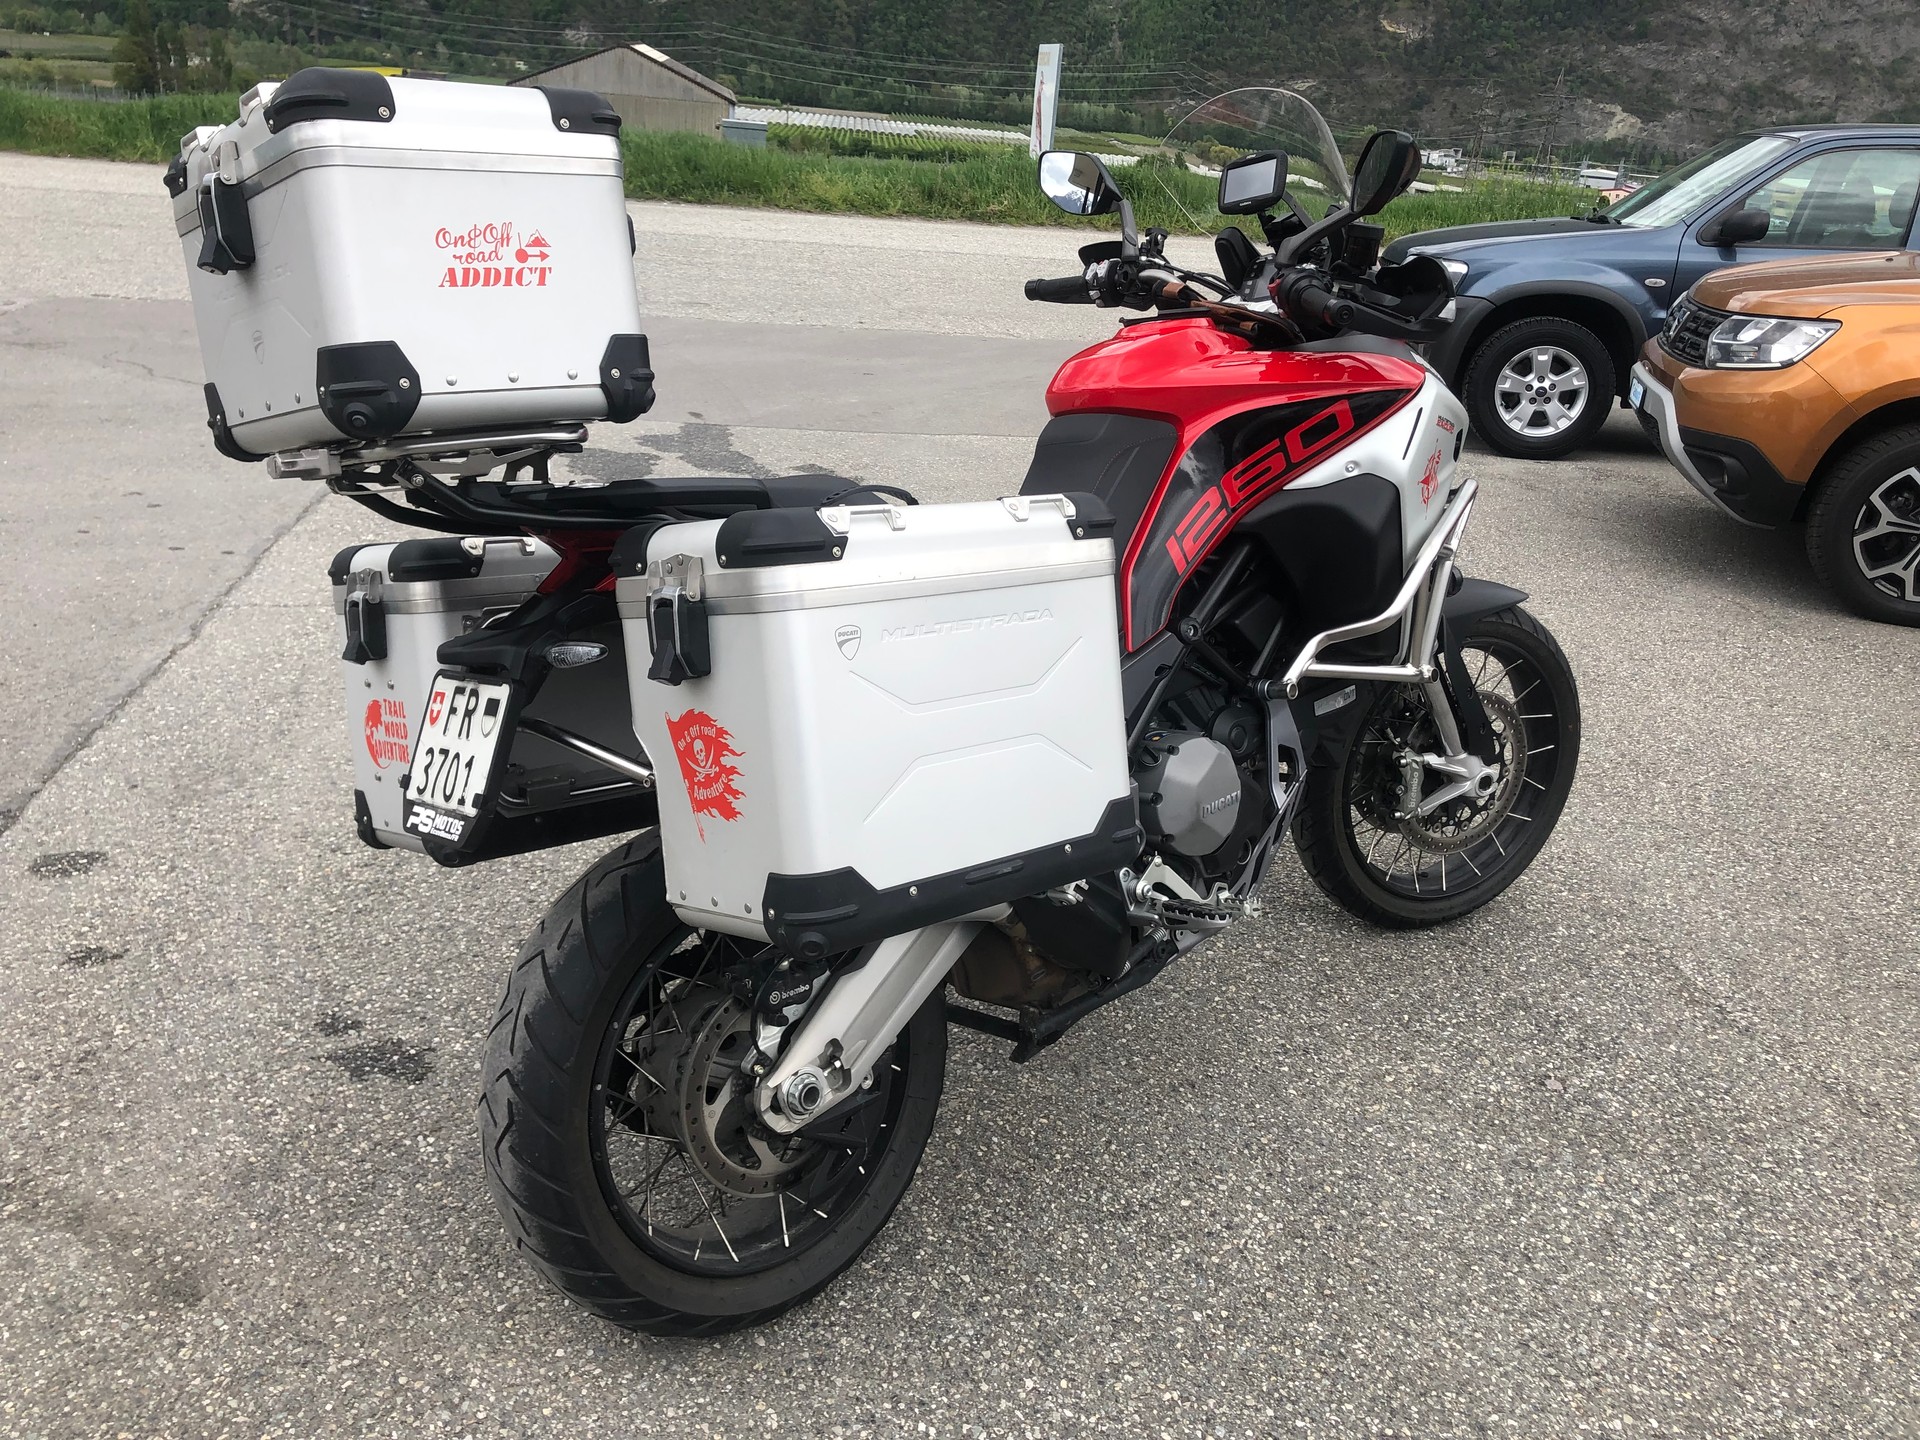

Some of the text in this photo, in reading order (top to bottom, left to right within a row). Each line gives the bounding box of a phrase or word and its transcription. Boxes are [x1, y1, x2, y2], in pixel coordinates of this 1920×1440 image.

[452, 240, 503, 265] road
[438, 267, 552, 287] ADDICT
[1165, 399, 1355, 576] 1260
[837, 629, 859, 638] DUCATI
[881, 608, 1054, 643] MULTISTRADA
[383, 698, 406, 719] TRAIL
[442, 685, 480, 741] FR
[384, 720, 408, 740] WORLD
[677, 738, 687, 751] On
[690, 724, 700, 738] Off
[701, 726, 716, 738] road
[374, 739, 410, 764] ADVENTURE
[416, 747, 475, 806] 3701
[694, 773, 728, 801] Adventure
[1408, 771, 1419, 808] brembo
[1202, 790, 1241, 818] DUCATI
[406, 805, 436, 833] PS
[432, 813, 465, 836] MOTOS
[781, 984, 810, 1000] brembo
